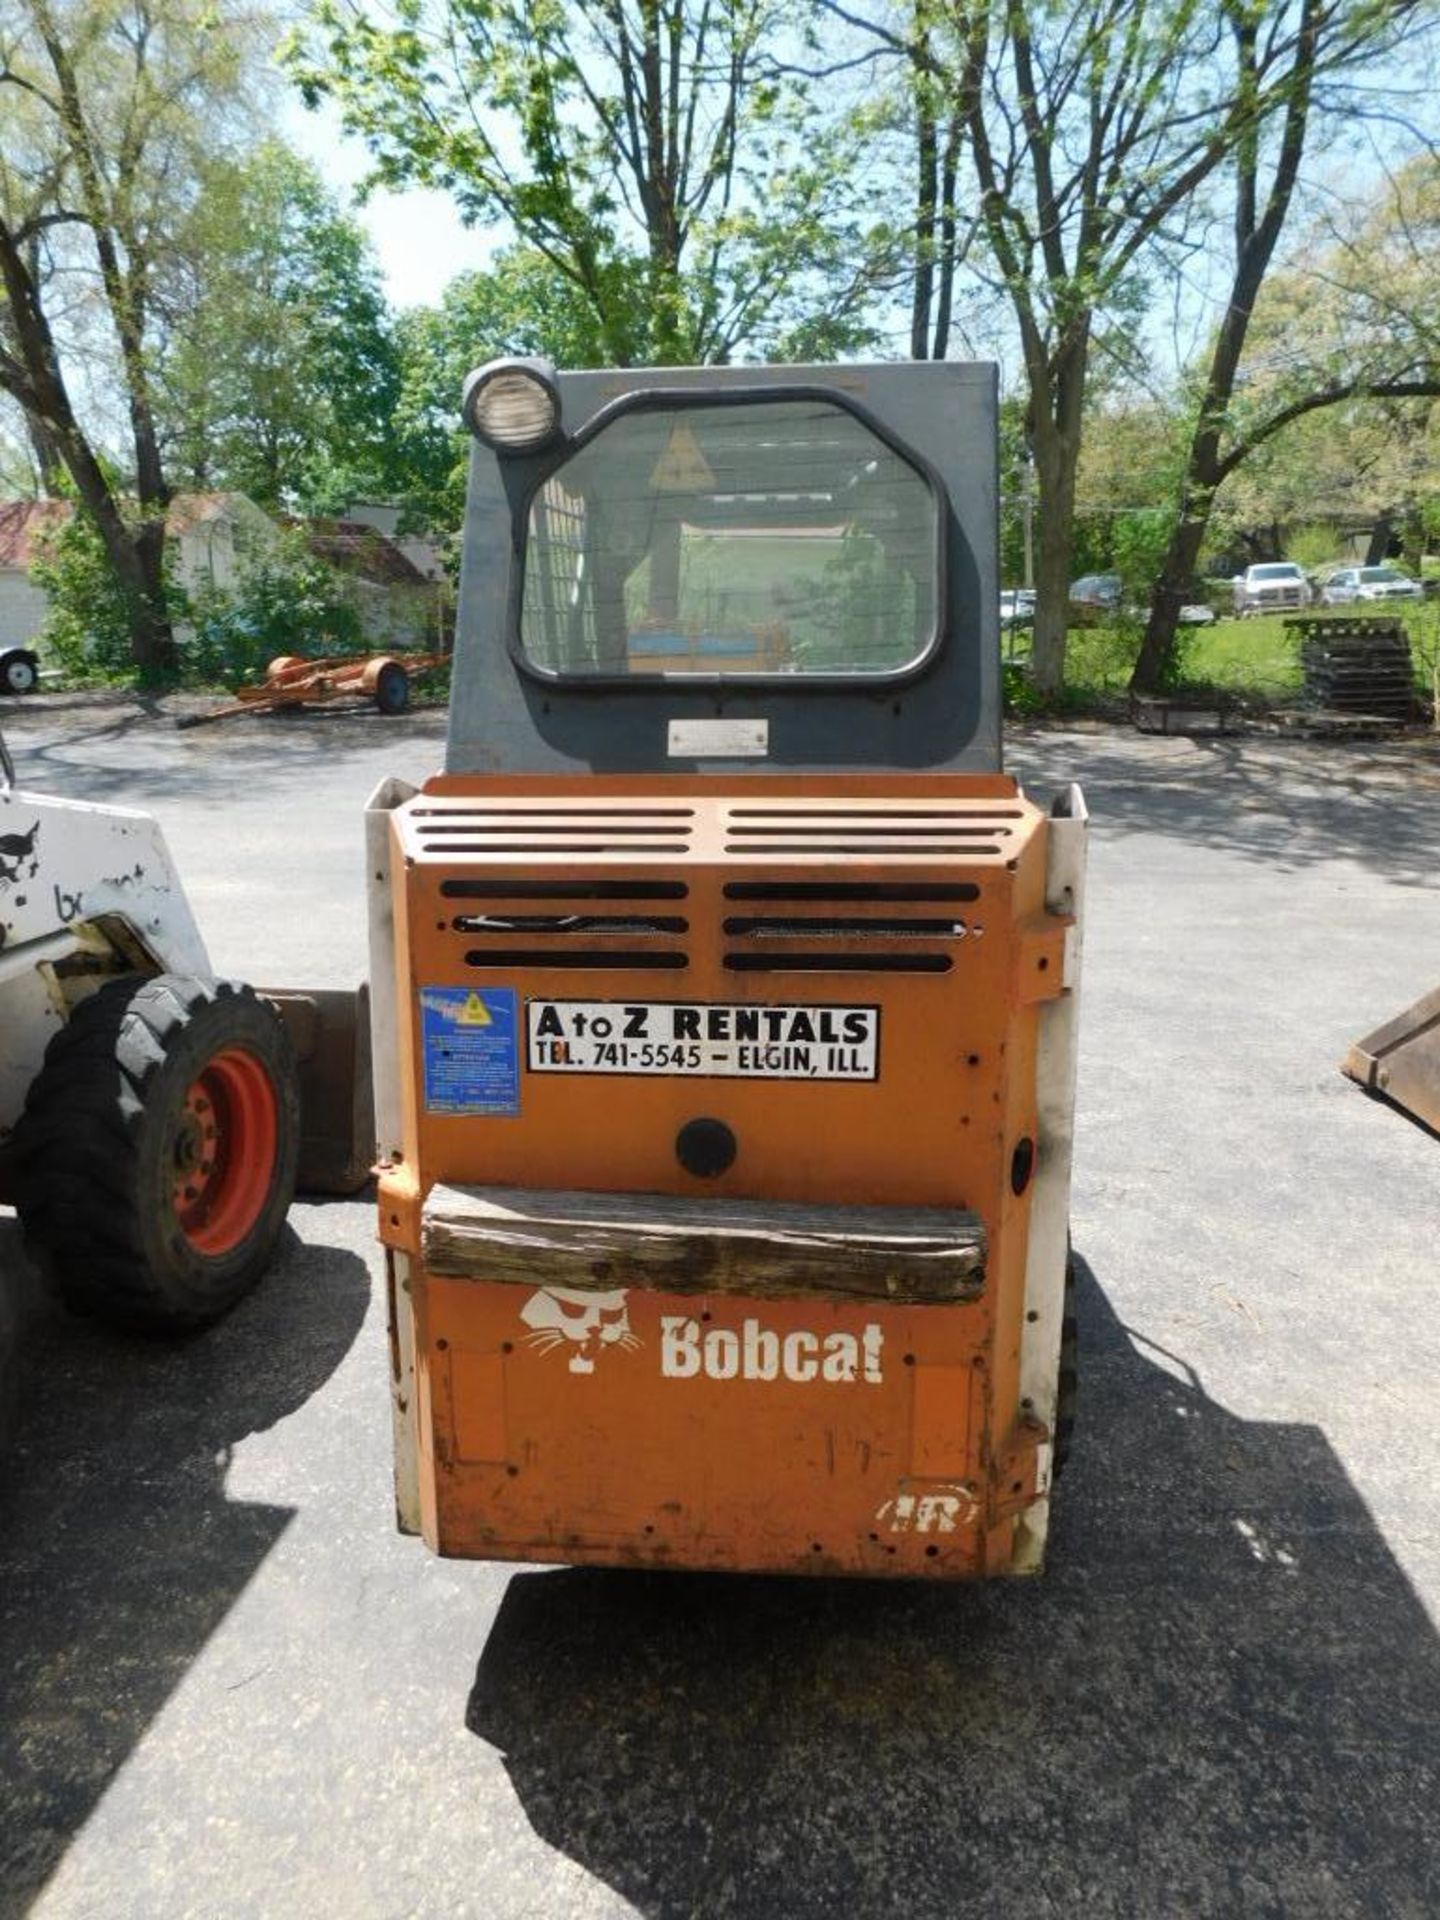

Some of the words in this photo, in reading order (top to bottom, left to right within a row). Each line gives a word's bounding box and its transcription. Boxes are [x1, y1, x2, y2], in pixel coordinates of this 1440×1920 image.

[536, 1005, 565, 1036] A
[572, 1012, 613, 1038] to
[623, 1007, 649, 1039] Z
[673, 1008, 869, 1045] RENTALS
[536, 1040, 584, 1065] TEL.
[592, 1042, 701, 1068] 741-5545
[738, 1046, 818, 1076] ELGIN,
[827, 1048, 869, 1073] ILL.
[660, 1316, 884, 1384] Bobcat
